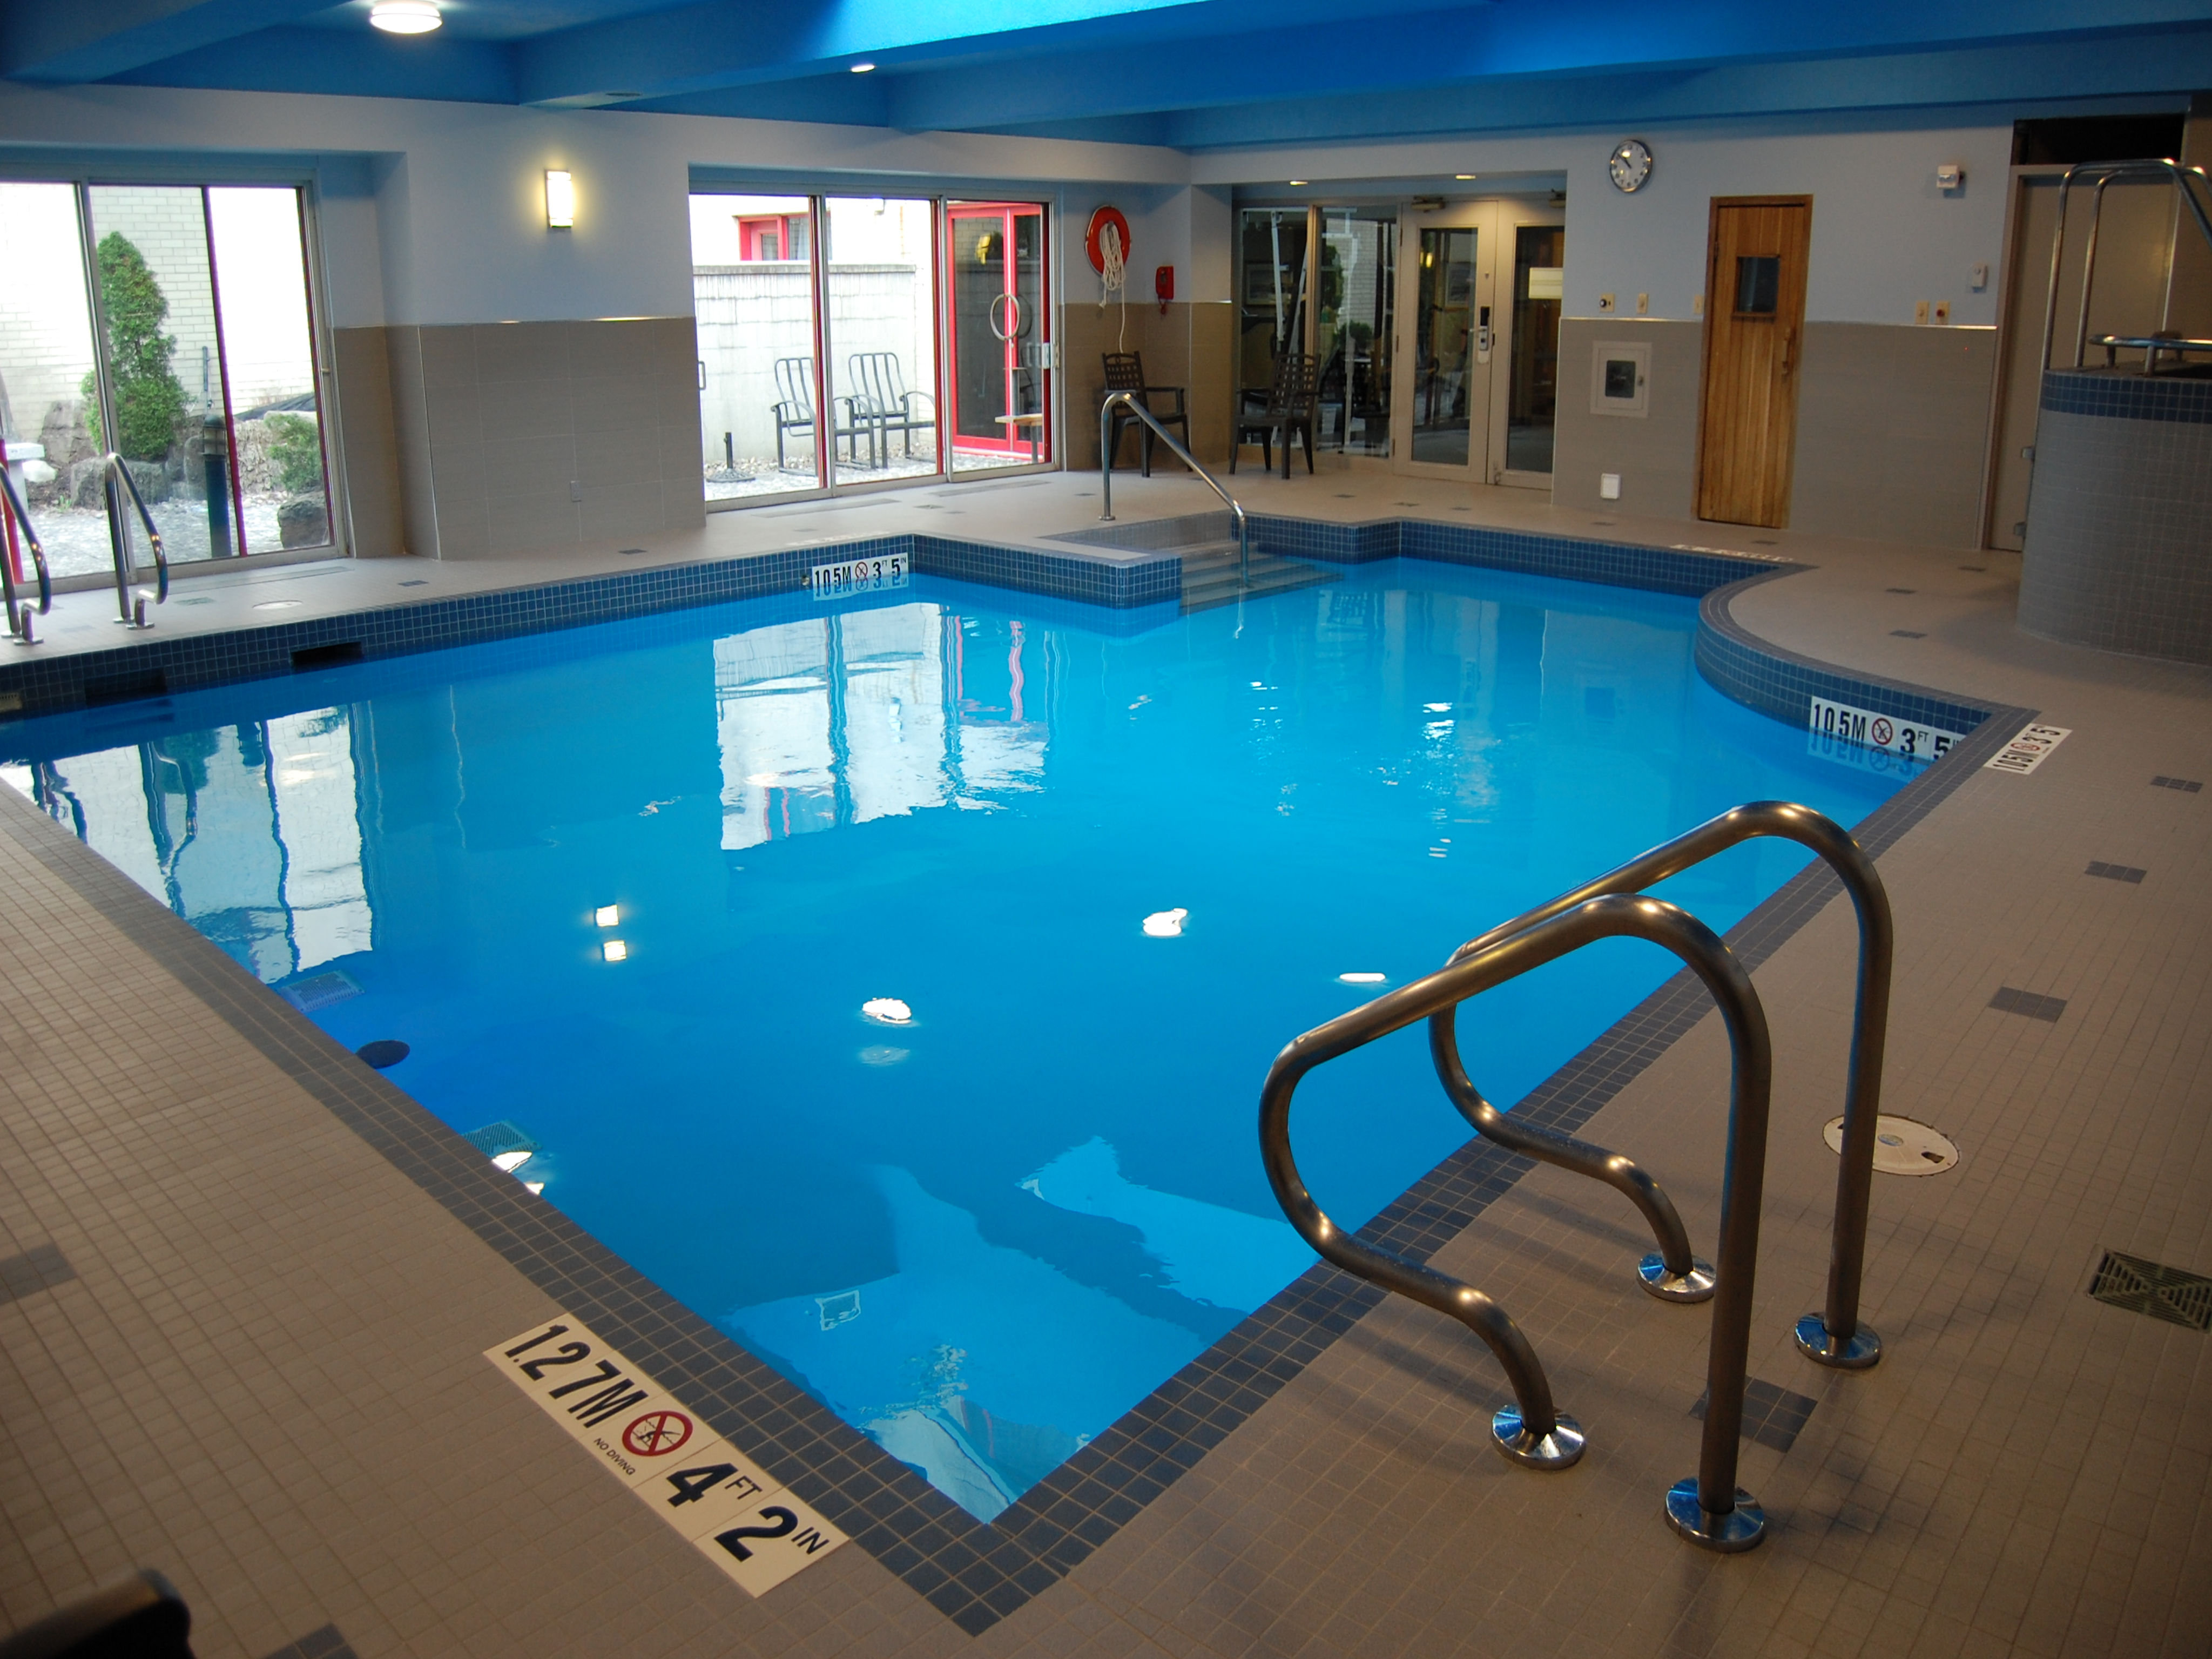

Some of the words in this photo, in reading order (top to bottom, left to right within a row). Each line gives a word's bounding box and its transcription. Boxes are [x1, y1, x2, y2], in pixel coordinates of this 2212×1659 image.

[873, 561, 881, 579] 3
[892, 558, 901, 576] 5
[1900, 728, 1916, 761] 3
[1918, 731, 1929, 743] FT
[1933, 735, 1951, 760] 5
[2031, 727, 2061, 736] 5
[504, 1325, 648, 1429] 1.27M
[594, 1438, 609, 1450] NO
[606, 1449, 636, 1475] DIVING
[665, 1462, 739, 1508] 4
[724, 1475, 763, 1500] FT
[713, 1505, 799, 1563] 2
[791, 1526, 830, 1555] IN
